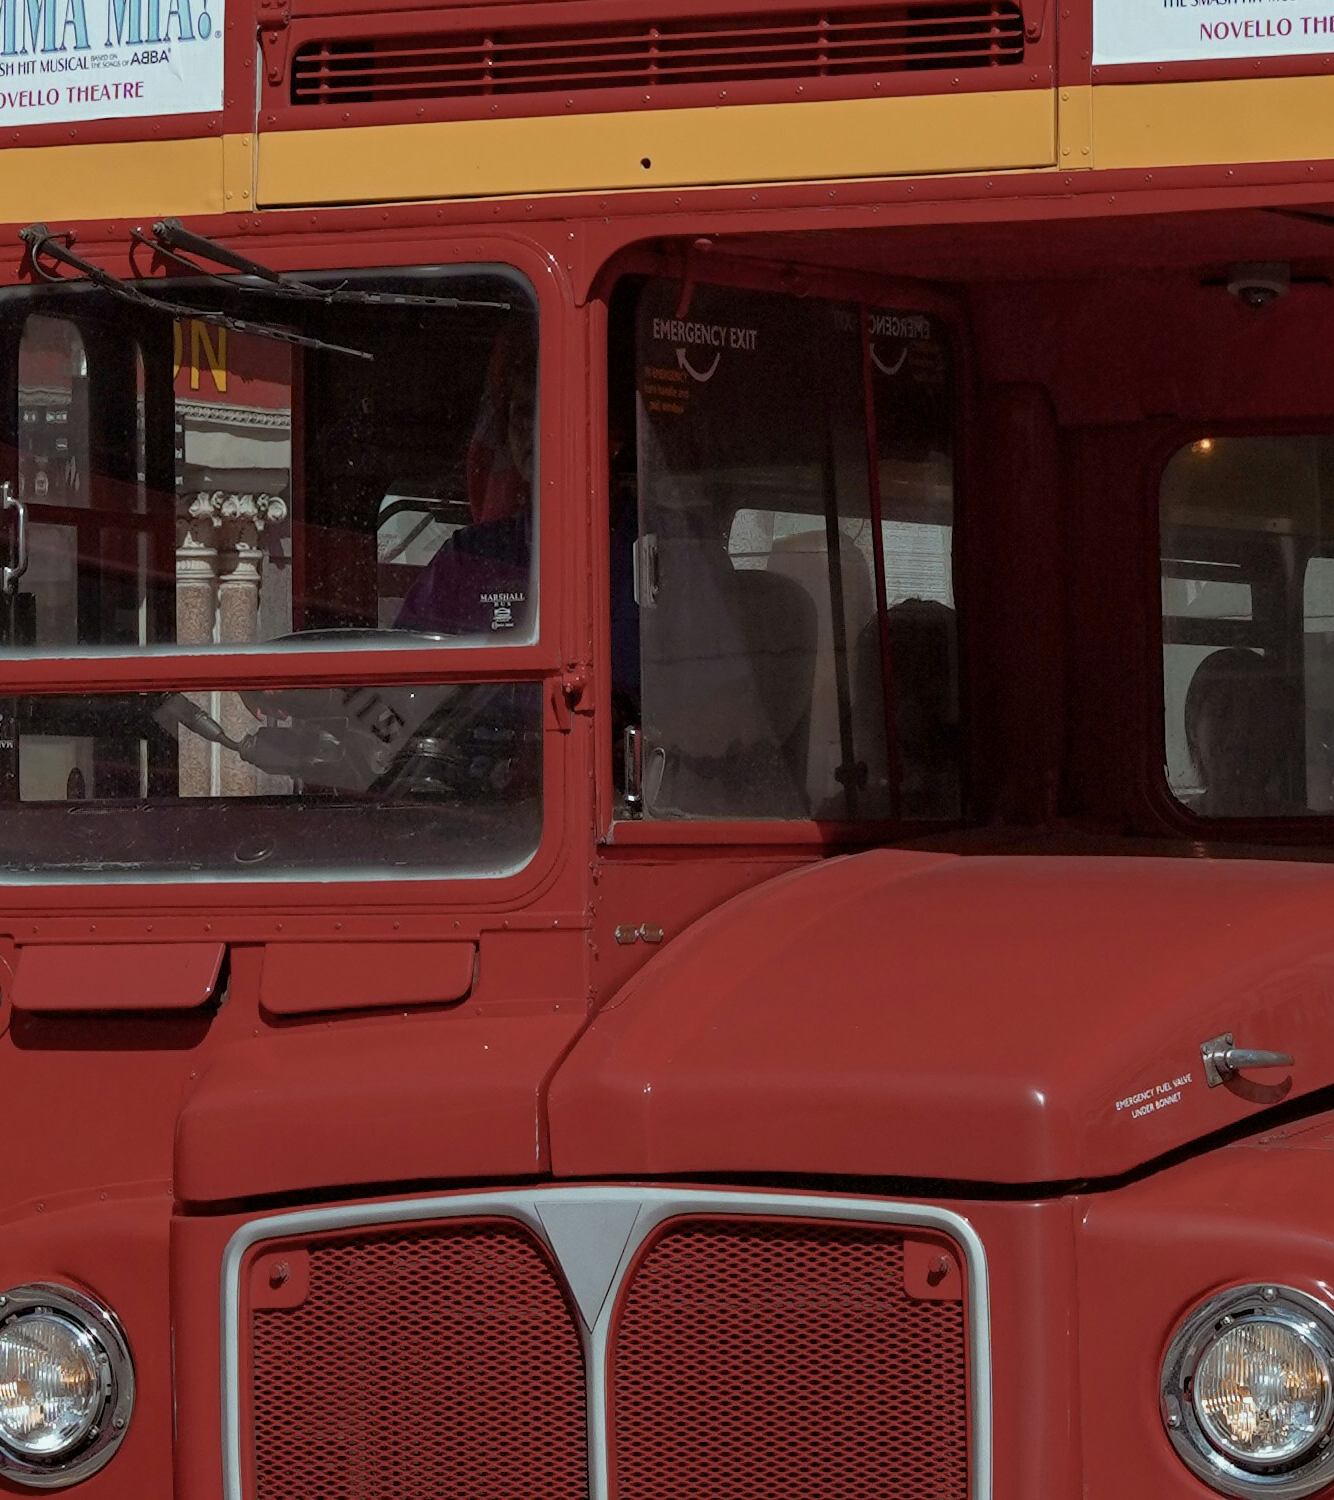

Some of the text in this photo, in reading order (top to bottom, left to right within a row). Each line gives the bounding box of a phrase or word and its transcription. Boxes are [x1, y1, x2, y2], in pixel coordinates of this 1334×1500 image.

[1199, 16, 1293, 41] NOVELLO
[17, 58, 37, 75] HIT
[39, 55, 91, 74] MUSICAL
[130, 49, 170, 67] ABBA
[66, 81, 145, 104] THEATRE
[652, 317, 758, 350] EMERGENCY EXIT
[479, 592, 526, 602] MARSHALL
[1115, 1072, 1193, 1111] EMERGENCY FUEL VALVE
[1131, 1091, 1182, 1119] UNDER BONNET
